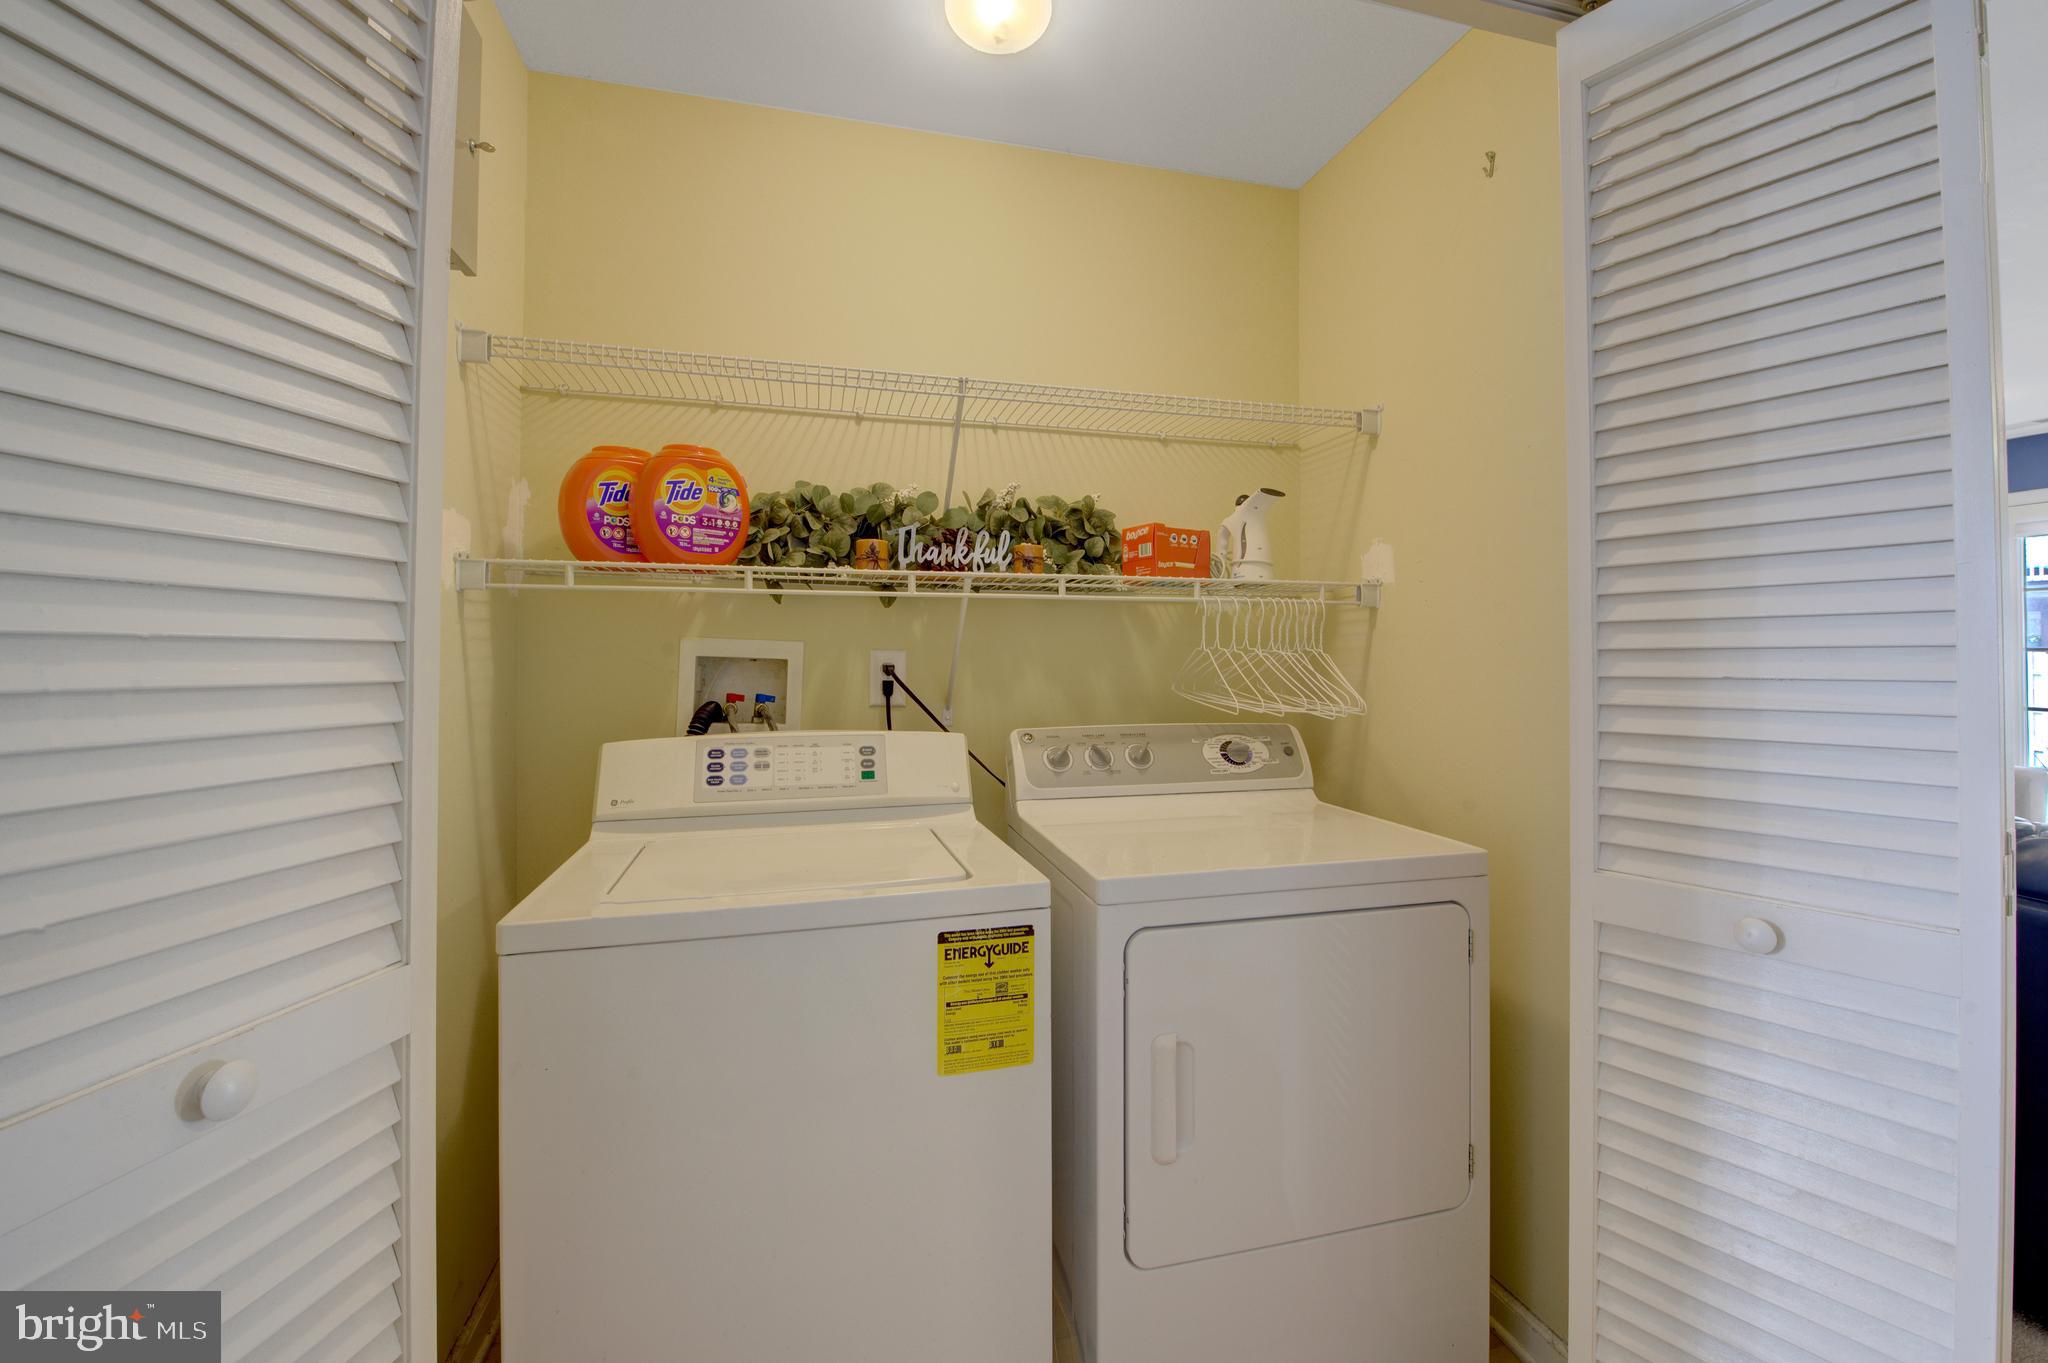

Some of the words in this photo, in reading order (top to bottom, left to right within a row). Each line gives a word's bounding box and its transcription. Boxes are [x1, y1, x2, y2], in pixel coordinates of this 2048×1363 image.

[665, 479, 704, 506] Tide
[671, 514, 697, 525] PODS
[887, 521, 1013, 572] Thankful
[944, 941, 1029, 962] ENERGYGUIDE
